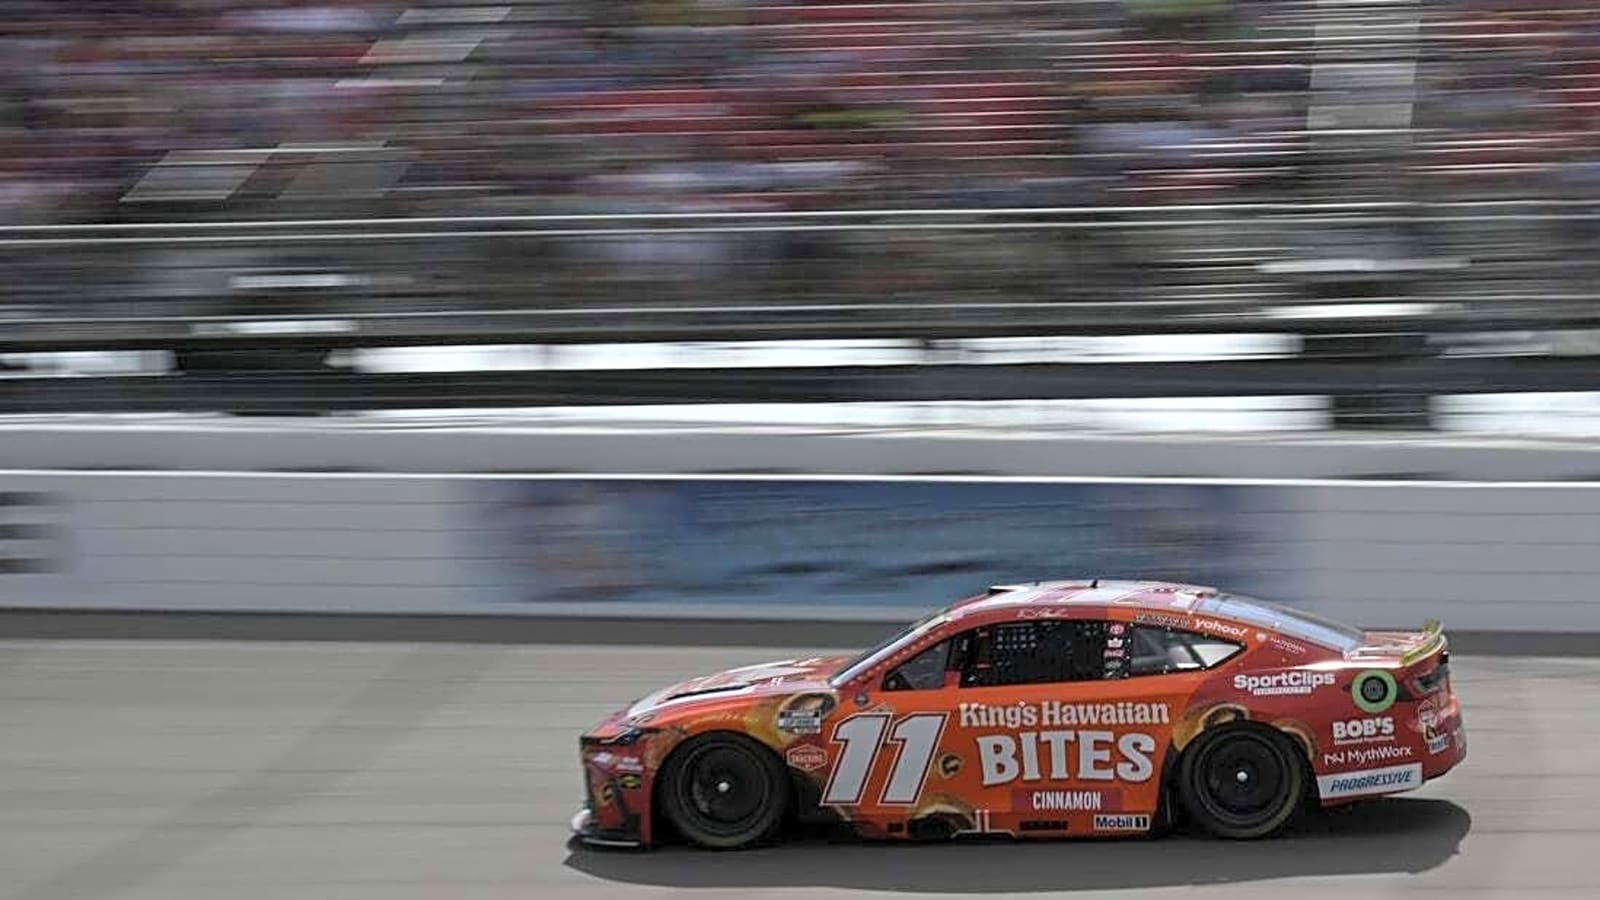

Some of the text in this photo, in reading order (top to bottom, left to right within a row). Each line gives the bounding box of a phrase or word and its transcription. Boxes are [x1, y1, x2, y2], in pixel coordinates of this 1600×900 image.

[1195, 618, 1249, 637] yahoo!
[1234, 671, 1335, 692] SportClips
[960, 700, 1170, 728] King's Hawaiian
[1333, 717, 1395, 739] BOB'S
[820, 711, 949, 807] 11
[977, 730, 1156, 786] BITES
[1347, 746, 1412, 764] MythWorx
[1330, 769, 1413, 792] PROGRESSIVE
[1032, 791, 1102, 811] CINNAMON
[1095, 816, 1133, 828] Mobil
